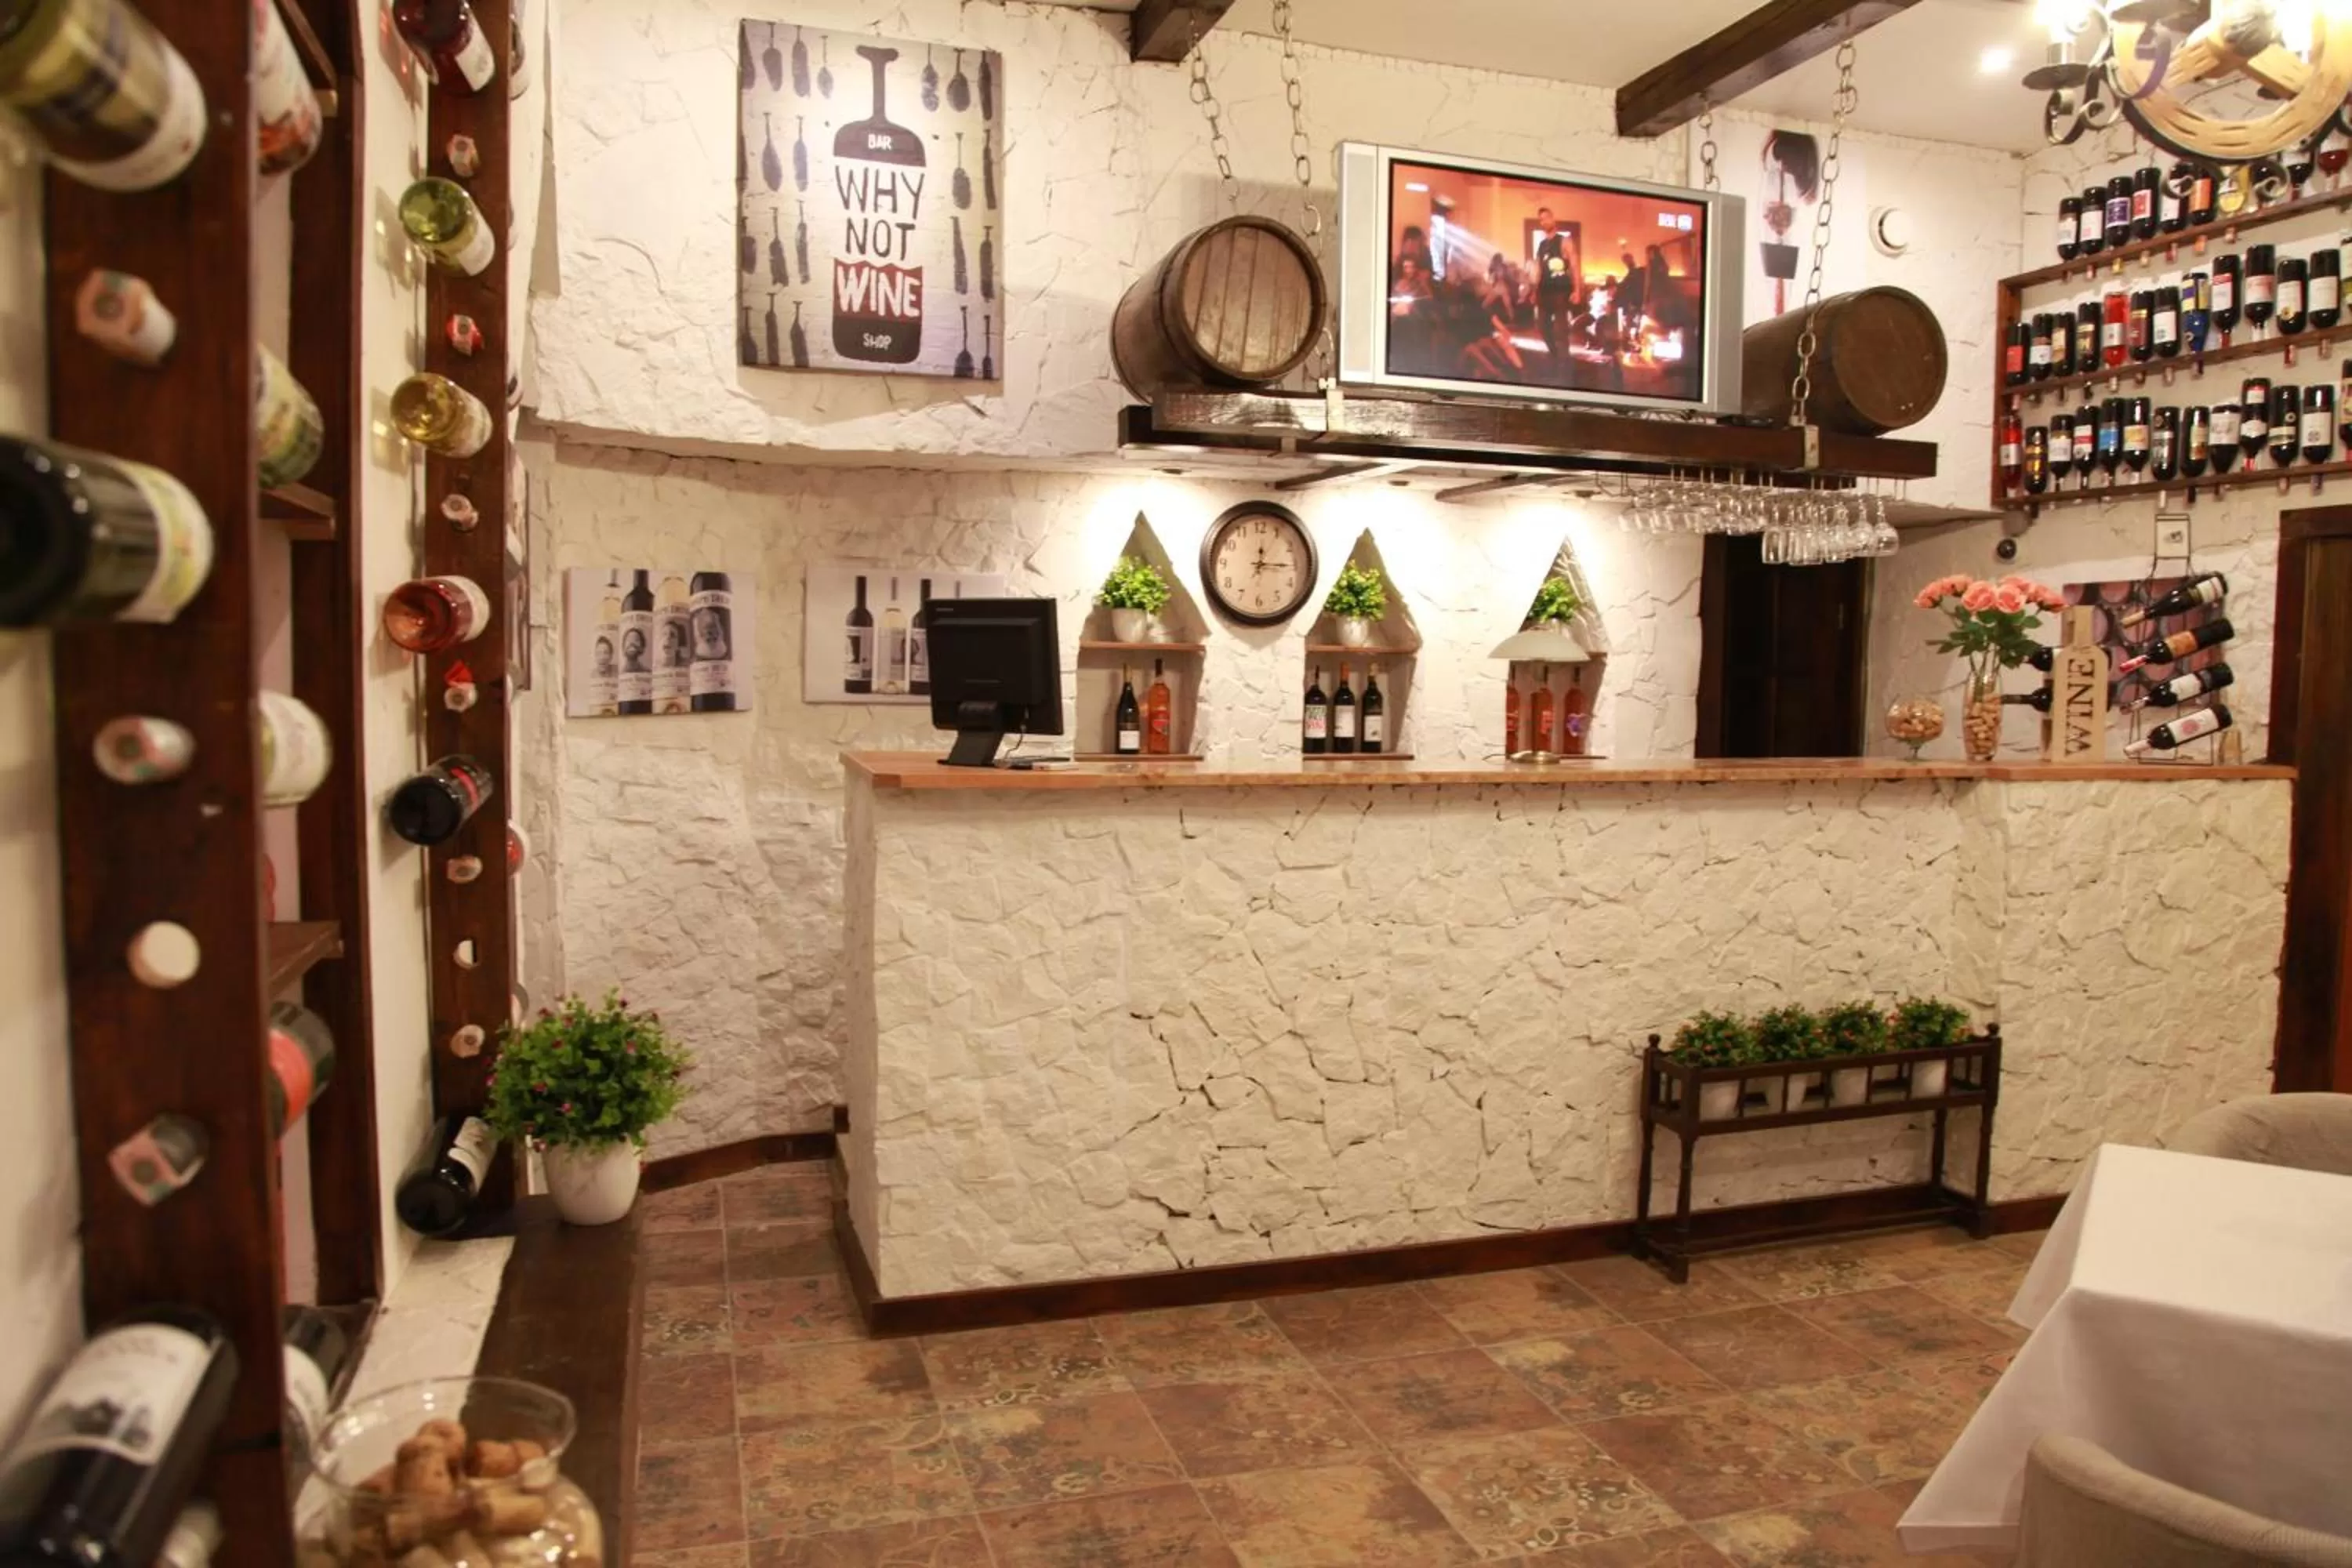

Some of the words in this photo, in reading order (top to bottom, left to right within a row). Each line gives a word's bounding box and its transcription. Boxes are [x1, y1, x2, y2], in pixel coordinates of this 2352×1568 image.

[867, 133, 892, 151] BAR
[835, 165, 925, 220] WHY
[846, 217, 916, 261] NOT
[837, 265, 920, 318] WINE
[862, 332, 892, 350] SHOP
[1236, 526, 1247, 539] 11
[1254, 521, 1267, 534] 12
[1220, 557, 1228, 571] 9
[1224, 576, 1232, 589] 8
[1254, 594, 1264, 607] 6
[2064, 657, 2096, 758] WINE
